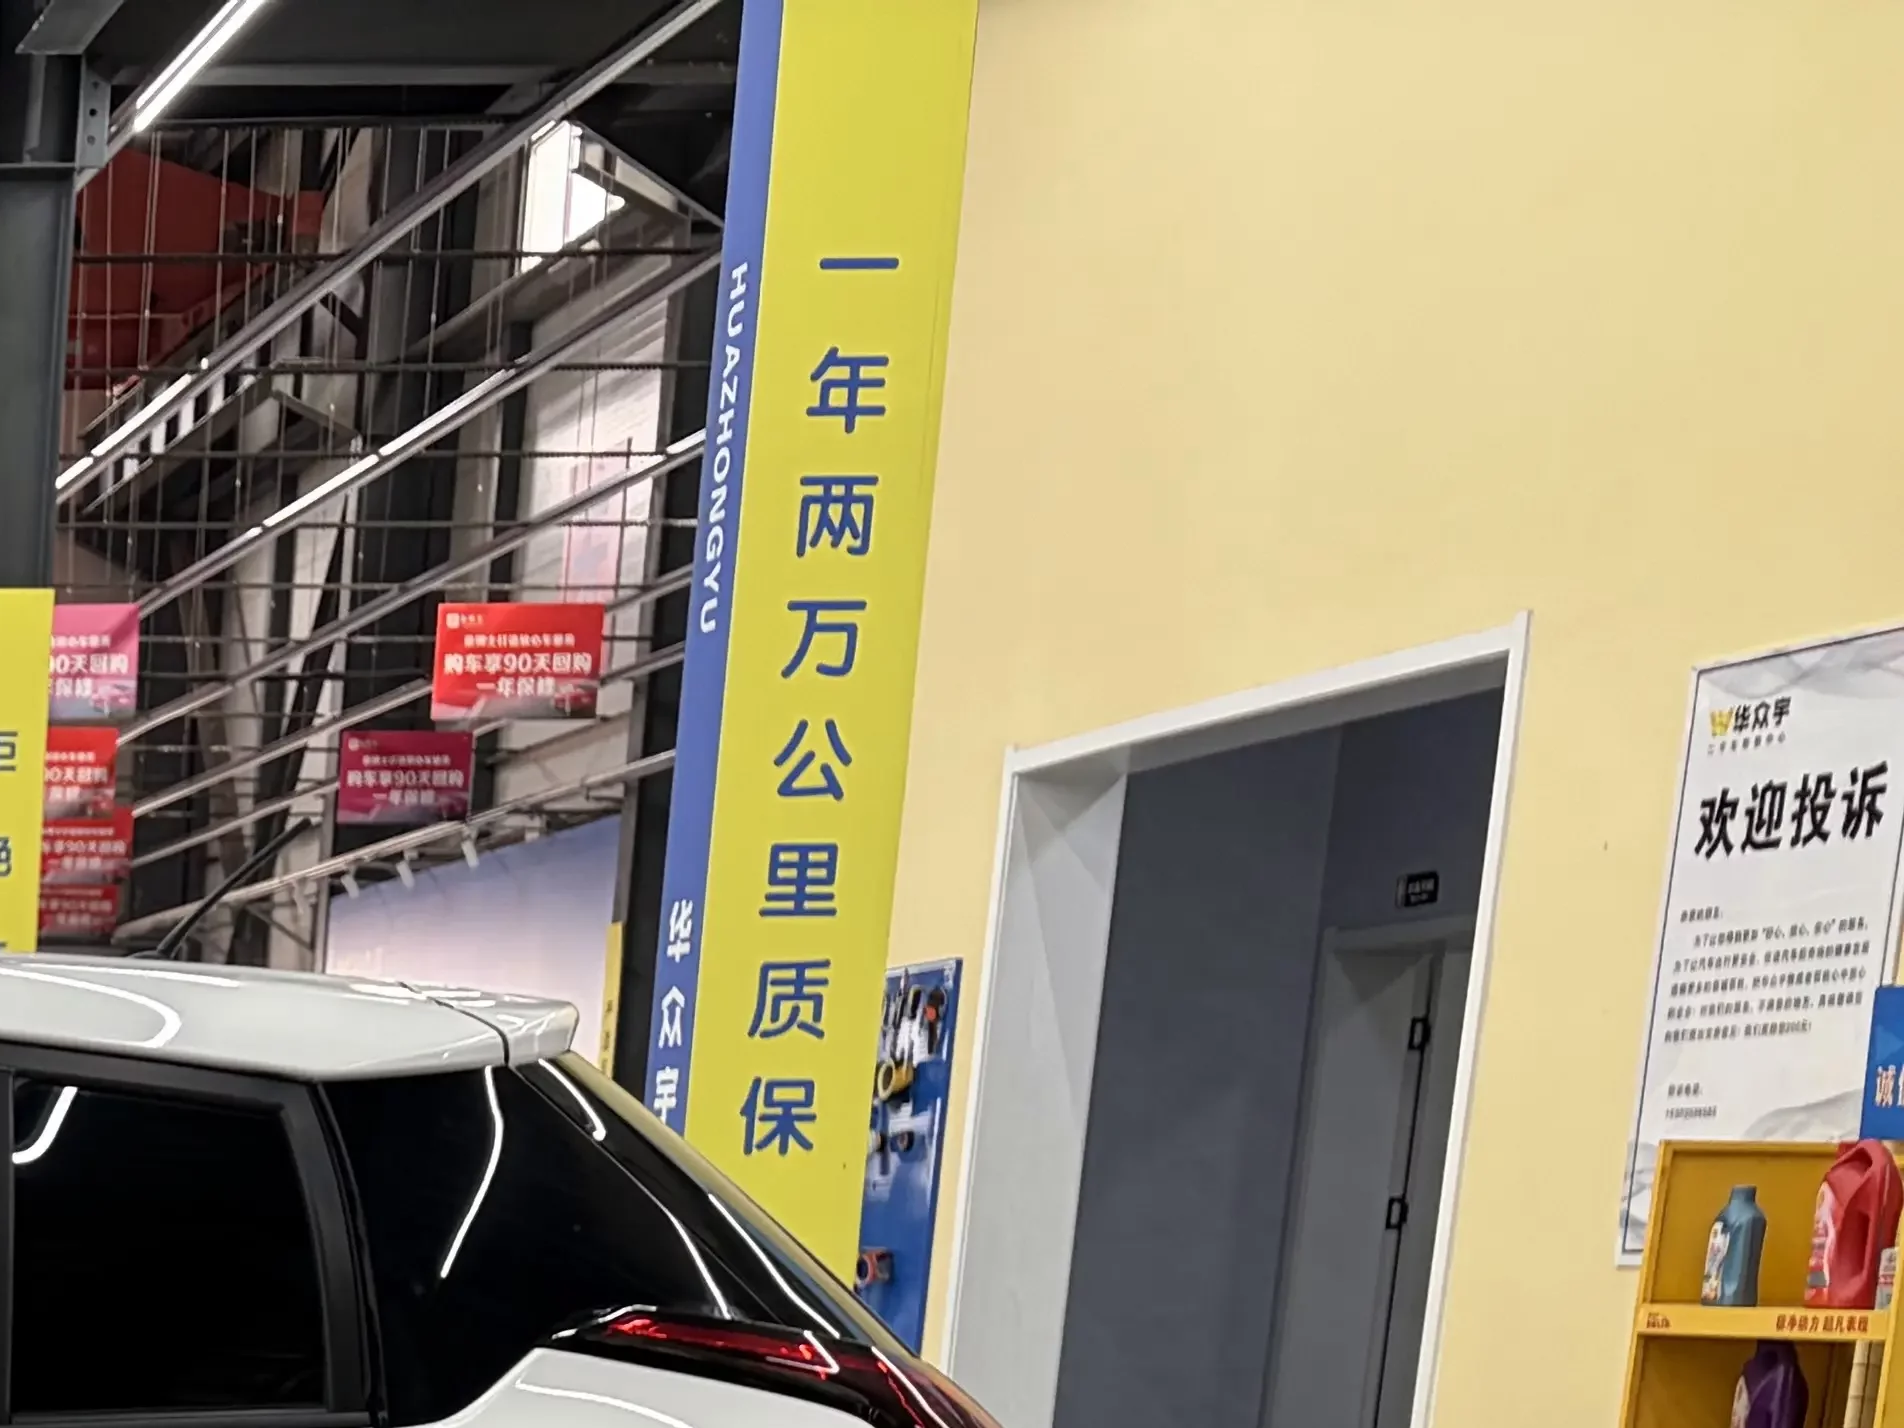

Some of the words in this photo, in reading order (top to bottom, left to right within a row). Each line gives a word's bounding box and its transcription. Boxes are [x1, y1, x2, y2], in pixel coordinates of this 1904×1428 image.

[700, 261, 749, 634] HUAZHONGYU
[444, 653, 593, 676] 购车享90天回购
[739, 256, 901, 1157] 一年两万公里质保
[1732, 696, 1792, 733] 华众宇
[1694, 760, 1889, 861] 欢迎投诉
[652, 898, 694, 1125] 华众宇
